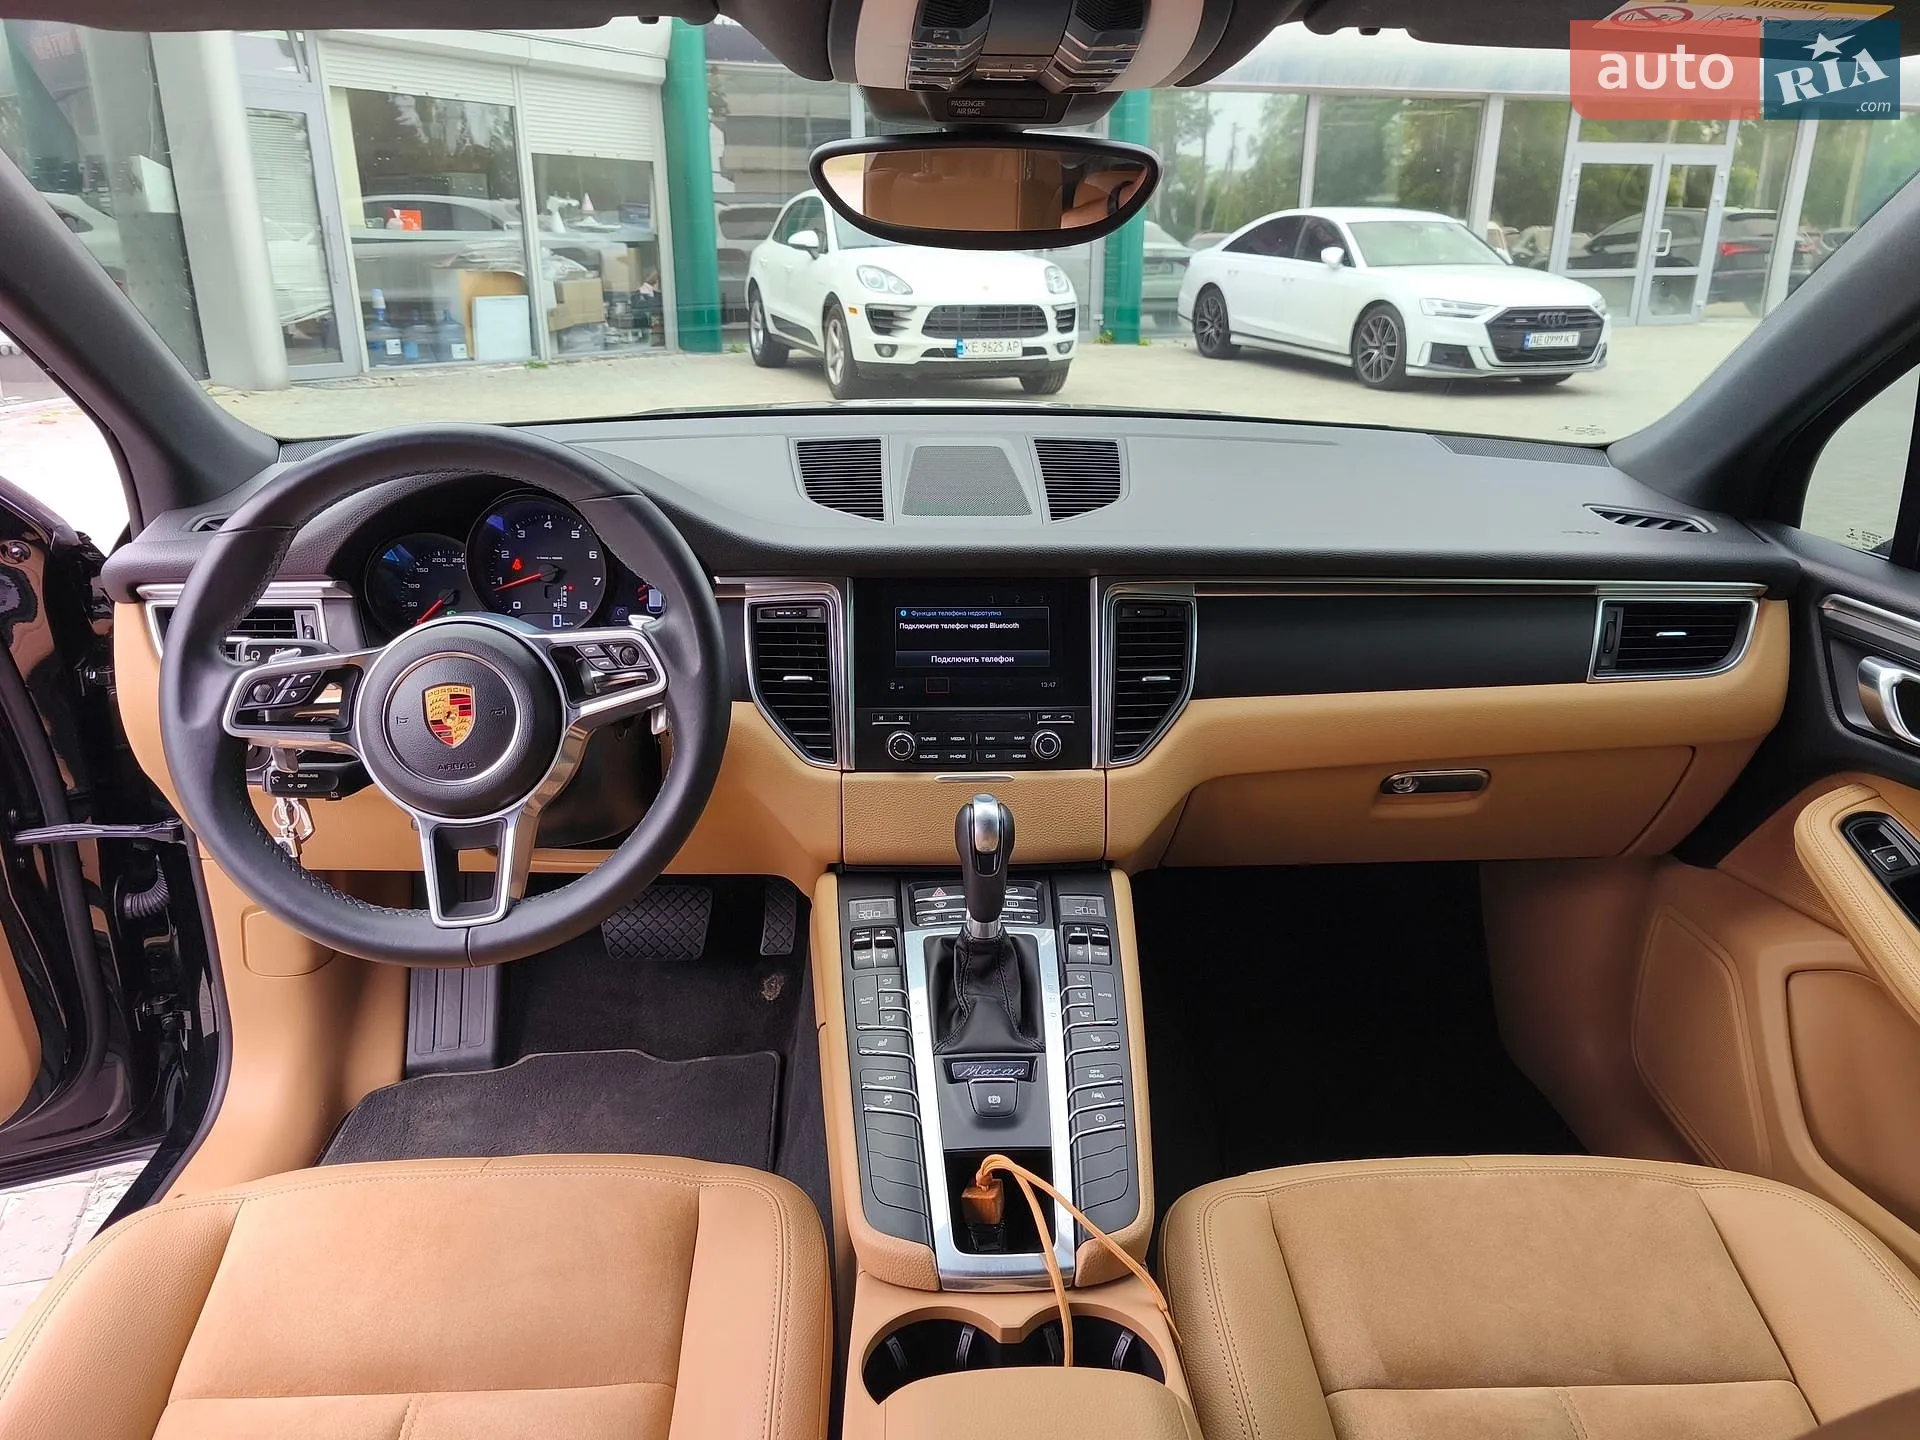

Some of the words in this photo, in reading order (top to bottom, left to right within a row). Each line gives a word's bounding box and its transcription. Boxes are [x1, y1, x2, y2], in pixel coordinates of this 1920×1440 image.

[1744, 0, 1828, 11] AIRBAG
[544, 521, 553, 530] 4
[517, 530, 526, 538] 3
[571, 530, 580, 539] 5
[501, 550, 510, 559] 2
[588, 550, 598, 559] 6
[497, 576, 503, 585] 1
[593, 577, 602, 586] 7
[513, 601, 521, 609] 0
[580, 601, 588, 610] 8
[899, 622, 940, 630] Подключите
[941, 622, 969, 630] телефон
[931, 655, 979, 665] Подключить
[981, 655, 1015, 664] телефон
[427, 687, 471, 698] PORSCHE
[957, 1065, 1025, 1078] Macan
